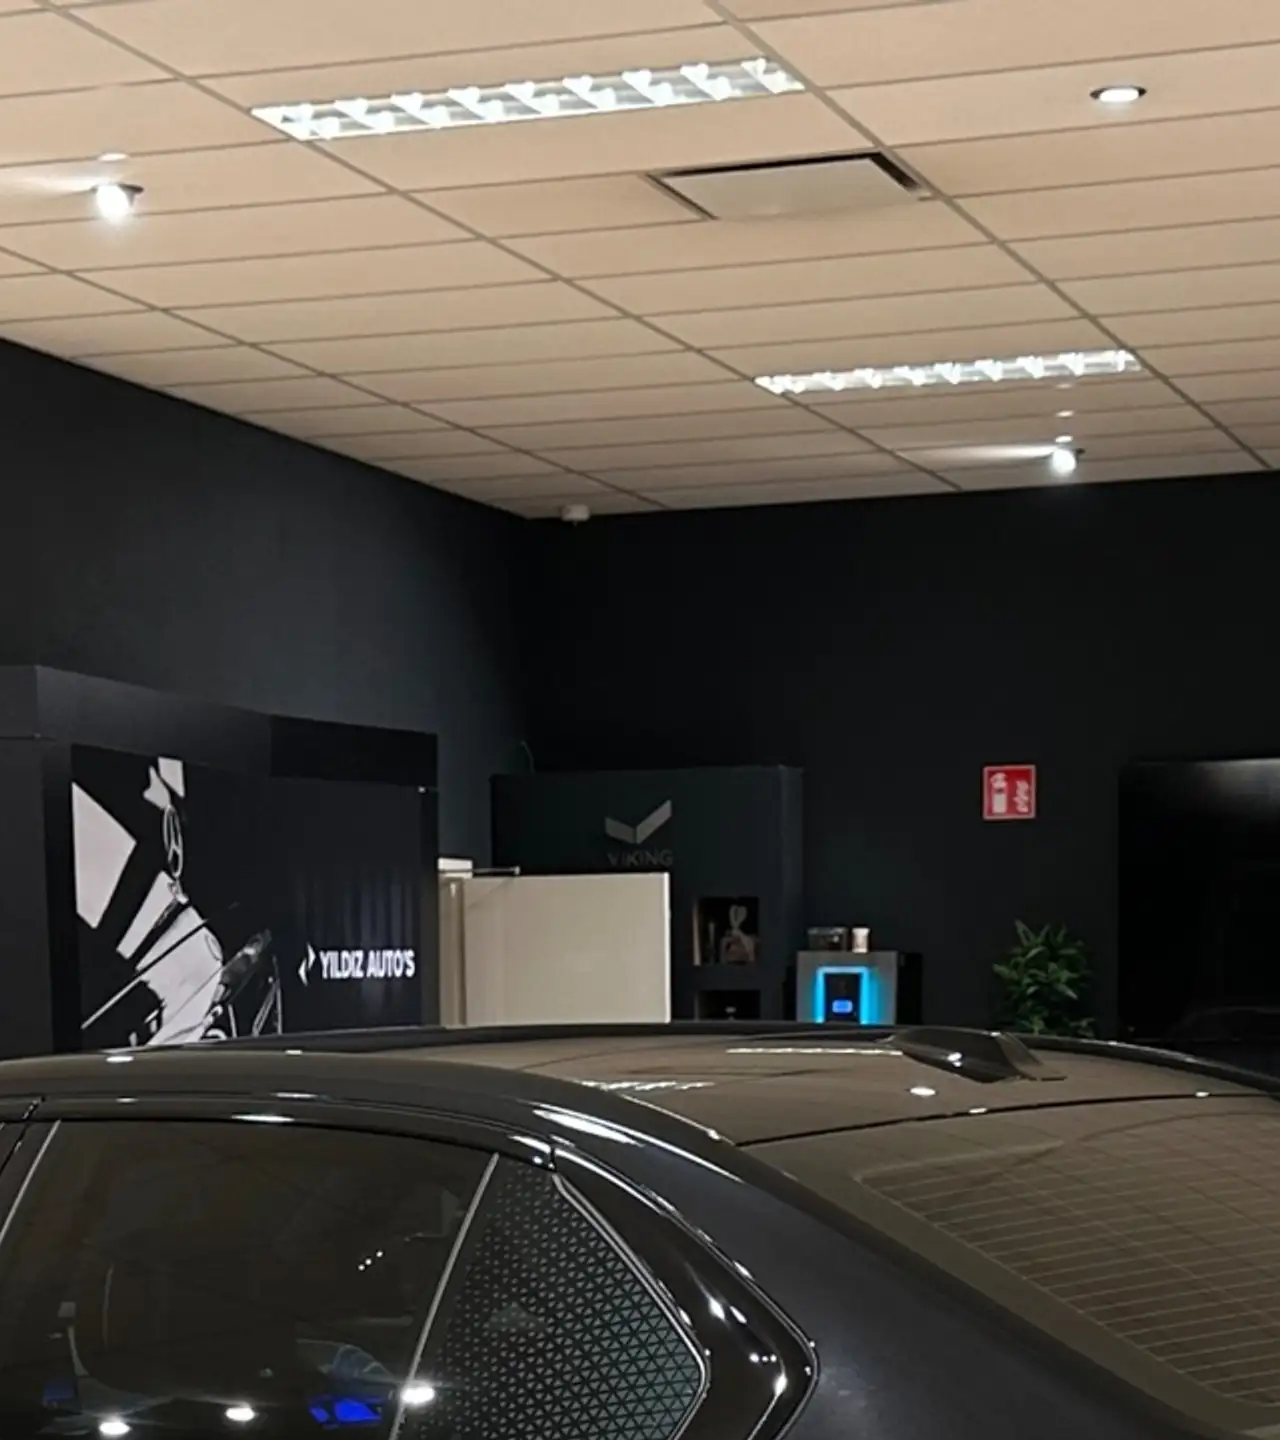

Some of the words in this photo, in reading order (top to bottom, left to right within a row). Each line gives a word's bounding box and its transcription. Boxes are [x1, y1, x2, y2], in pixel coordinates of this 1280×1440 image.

[607, 849, 673, 867] VIKING
[319, 949, 364, 979] YILDIZ
[366, 948, 416, 978] AUTO'S
